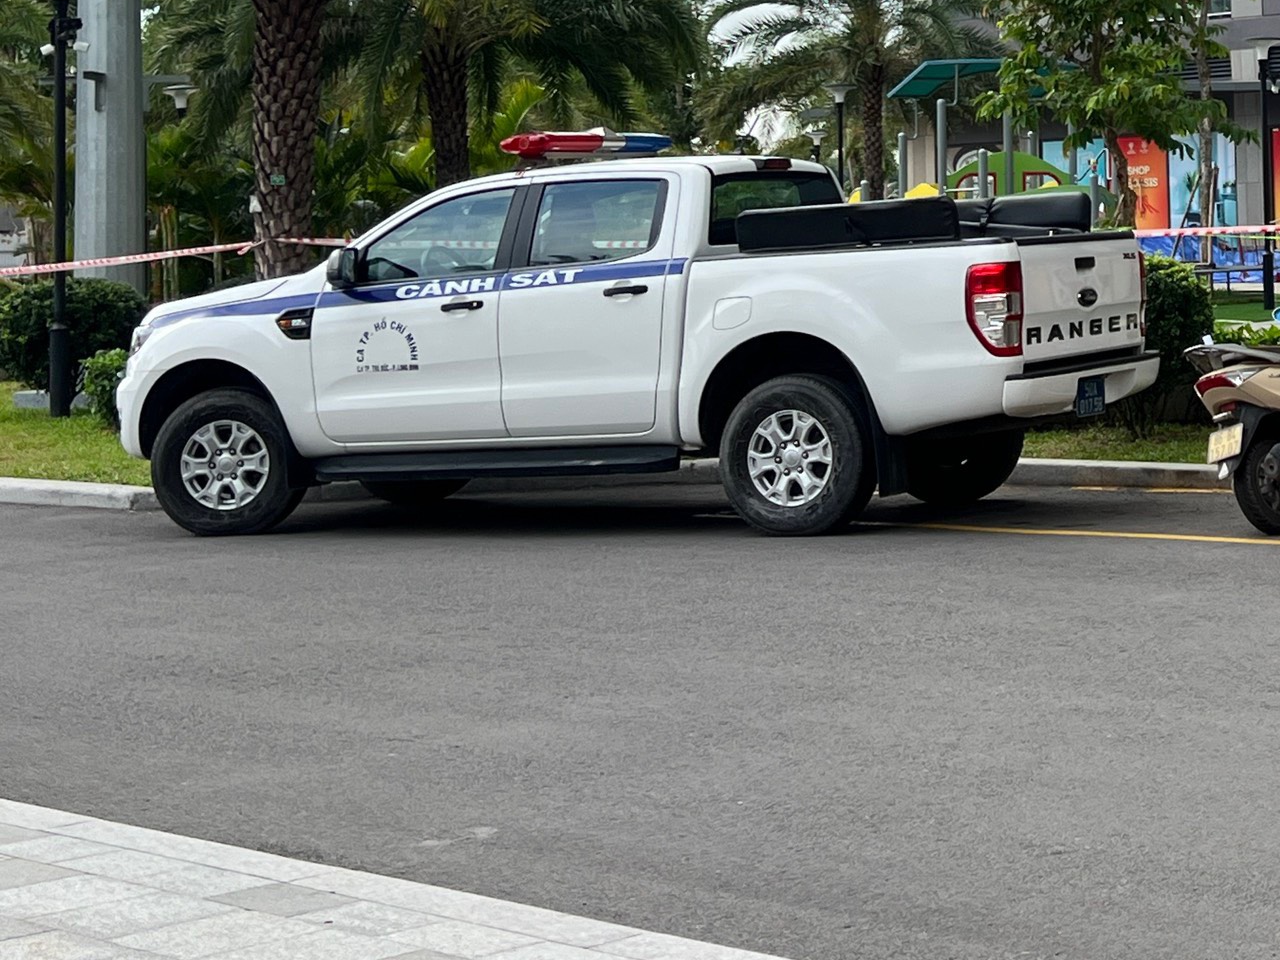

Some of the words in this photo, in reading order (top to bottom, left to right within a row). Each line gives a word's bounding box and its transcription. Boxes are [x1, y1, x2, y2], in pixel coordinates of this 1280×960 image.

[1127, 165, 1151, 176] SHOP
[1026, 313, 1138, 345] RANGER
[404, 332, 419, 361] MINH
